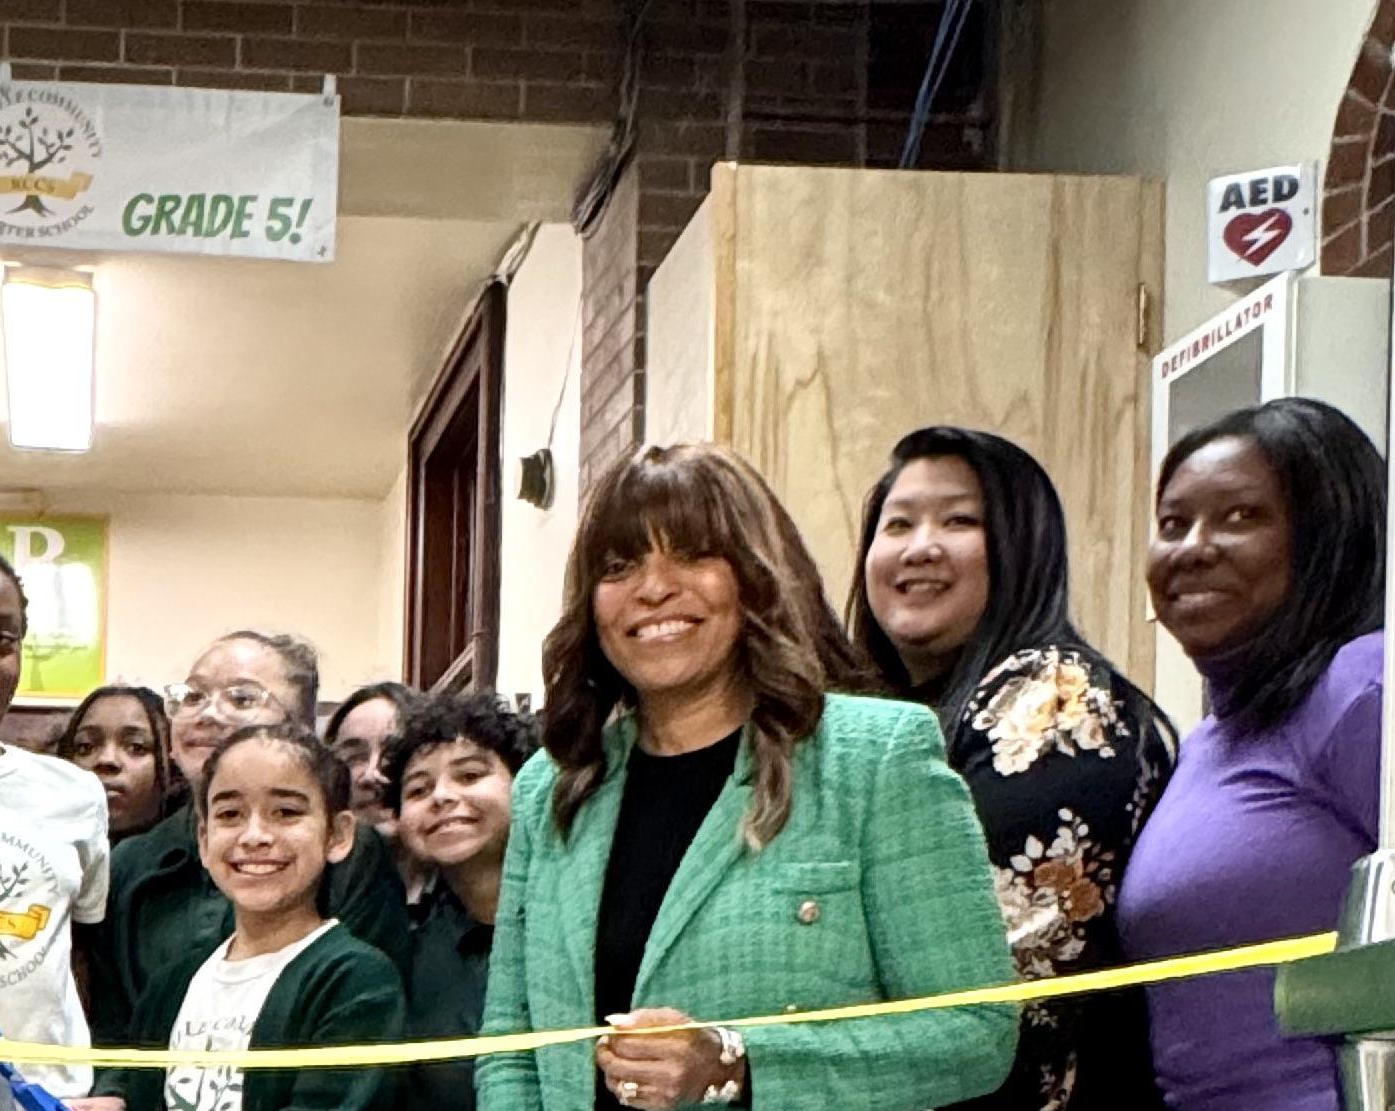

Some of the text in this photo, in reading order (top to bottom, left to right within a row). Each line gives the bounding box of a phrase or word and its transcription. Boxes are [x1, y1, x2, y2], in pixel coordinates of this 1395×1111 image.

[1219, 174, 1299, 213] AED
[36, 204, 95, 238] SCHOOL
[121, 192, 258, 240] GRADE
[265, 196, 313, 245] 5!
[1161, 293, 1274, 379] DEFIBRILLATOR
